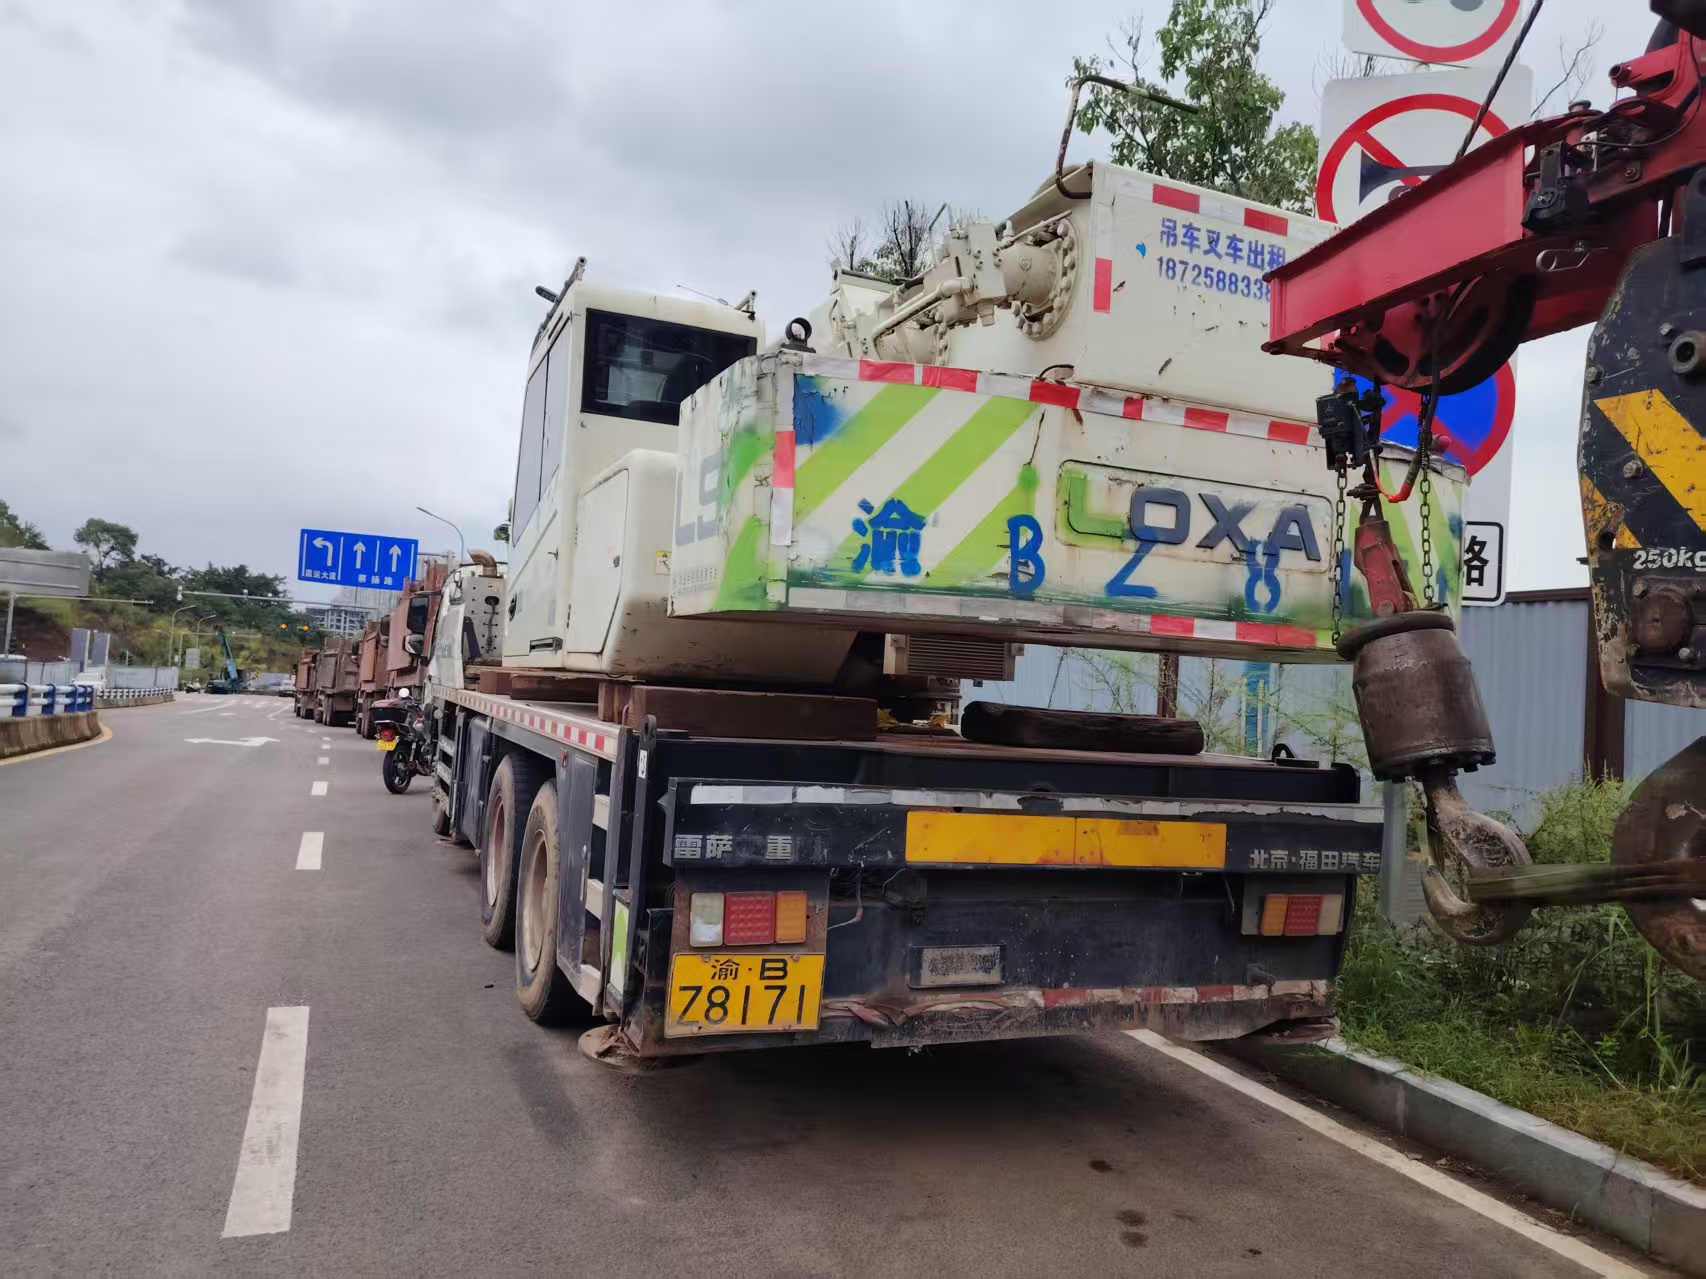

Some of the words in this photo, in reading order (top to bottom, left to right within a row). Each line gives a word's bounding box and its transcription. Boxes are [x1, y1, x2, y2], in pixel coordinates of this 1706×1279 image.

[1159, 217, 1286, 271] 吊车叉车出租
[677, 985, 806, 1026] Z8171
